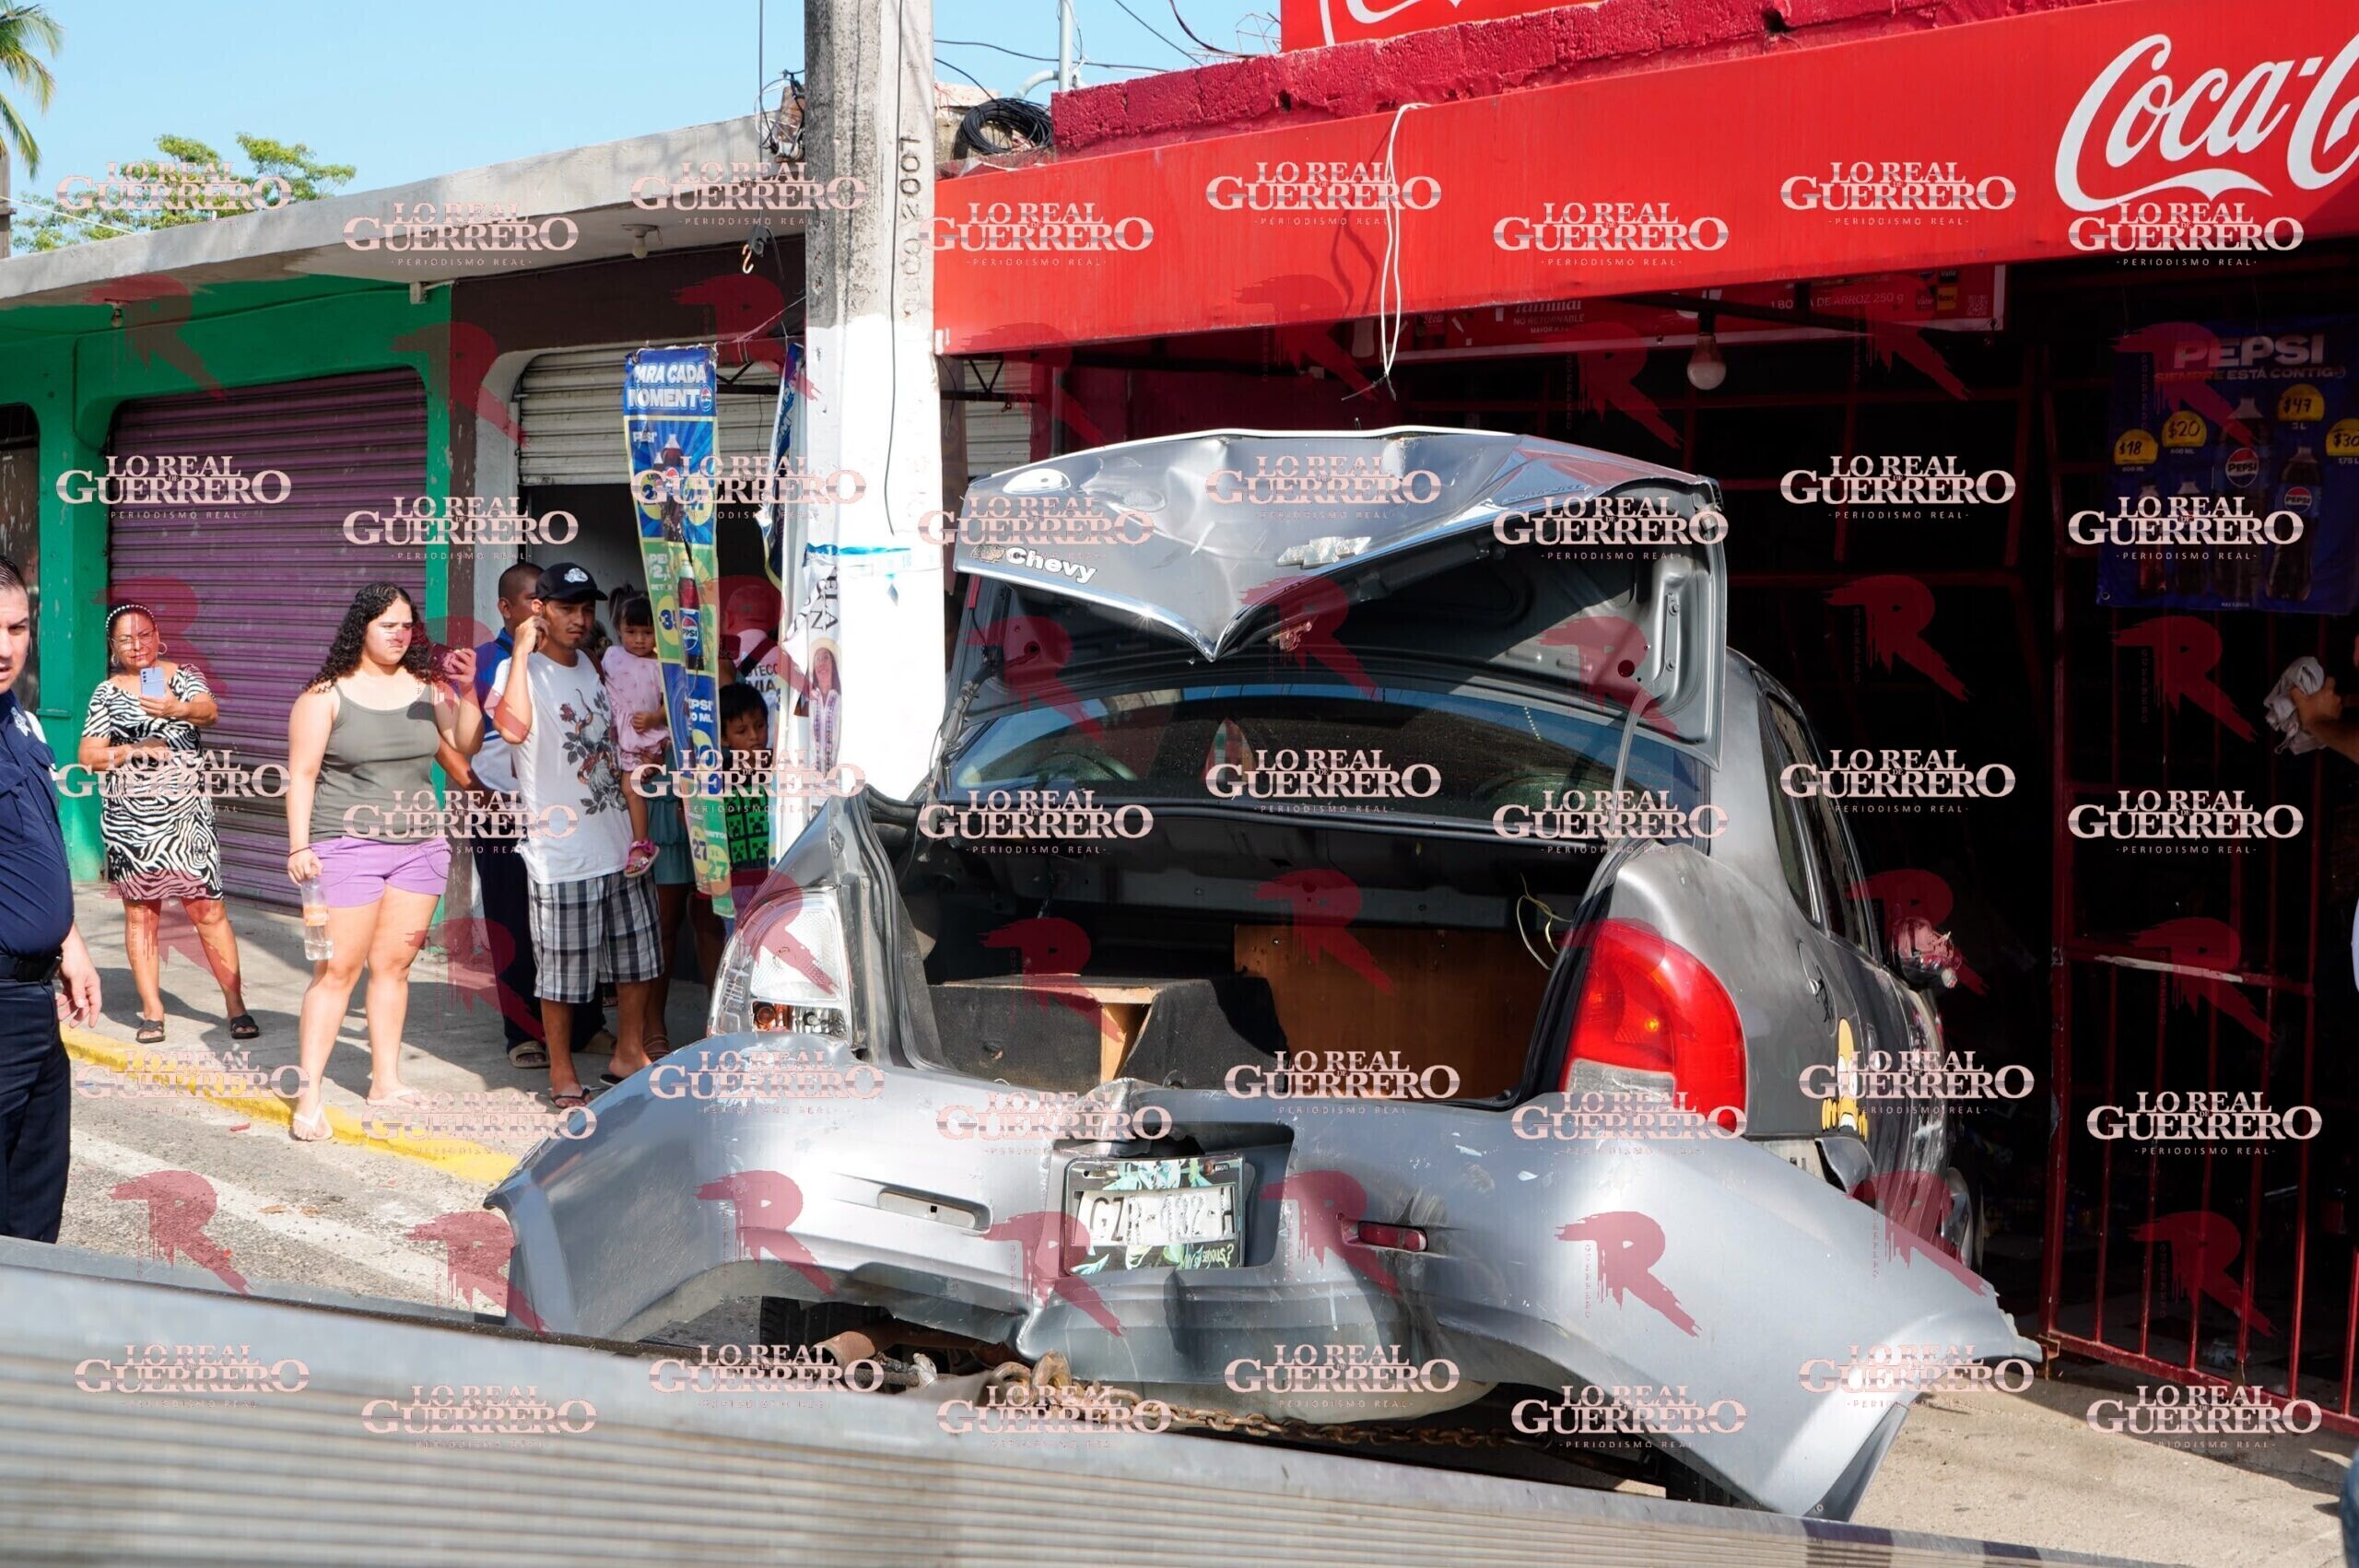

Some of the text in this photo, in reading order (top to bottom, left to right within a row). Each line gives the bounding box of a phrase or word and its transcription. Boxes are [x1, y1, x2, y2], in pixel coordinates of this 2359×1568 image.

[1834, 294, 1871, 306] ARROZ
[1872, 293, 1895, 303] 250
[2173, 333, 2325, 369] PEPSI
[666, 364, 708, 384] CADA
[2154, 369, 2225, 383] SIEMPRE
[2226, 367, 2268, 381] ESTÁ
[2167, 420, 2201, 439] $20
[2118, 440, 2142, 456] $18
[2226, 460, 2259, 474] PEPSI
[1005, 545, 1097, 584] Chevy
[692, 837, 708, 861] 27
